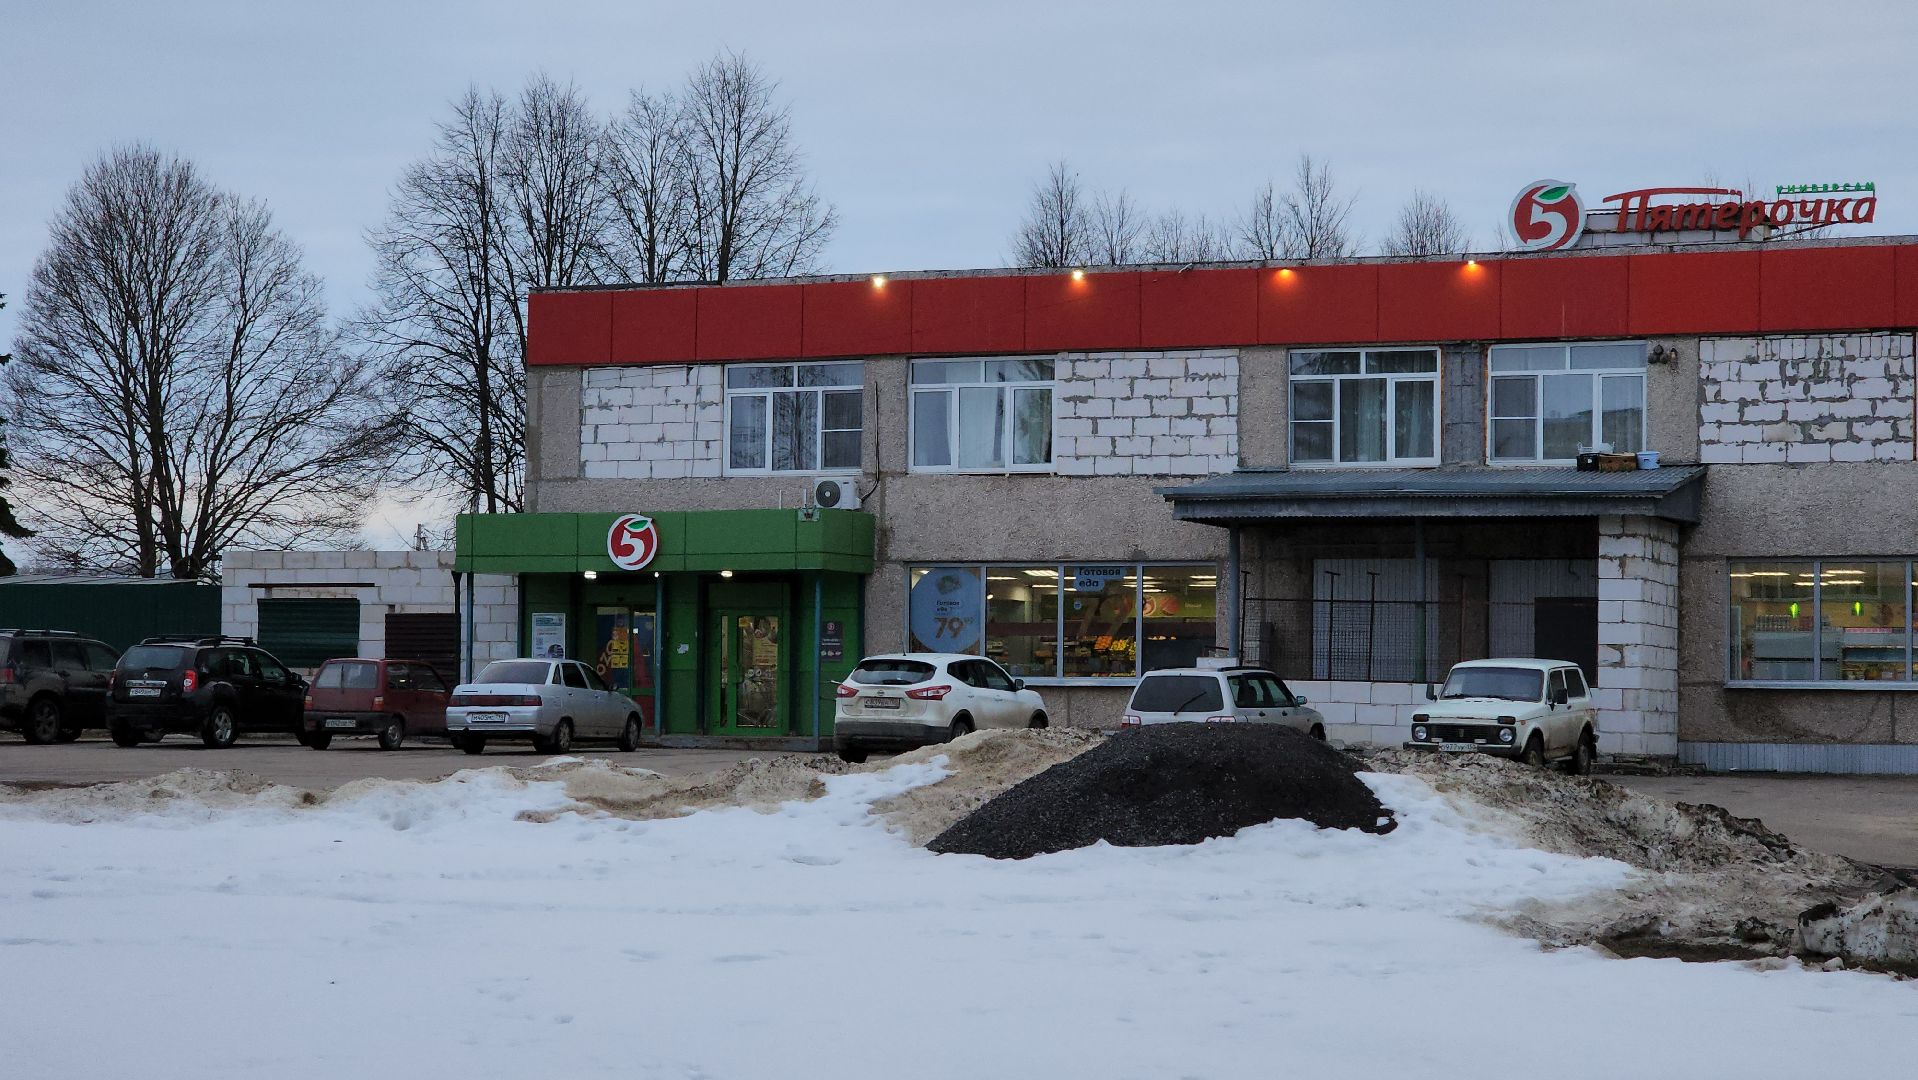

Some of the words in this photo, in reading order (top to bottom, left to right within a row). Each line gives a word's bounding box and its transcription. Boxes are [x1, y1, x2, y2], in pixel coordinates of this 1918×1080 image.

[1776, 182, 1875, 194] УНИВЕРСАМ
[1079, 567, 1121, 576] Готовая
[1079, 578, 1099, 587] еда
